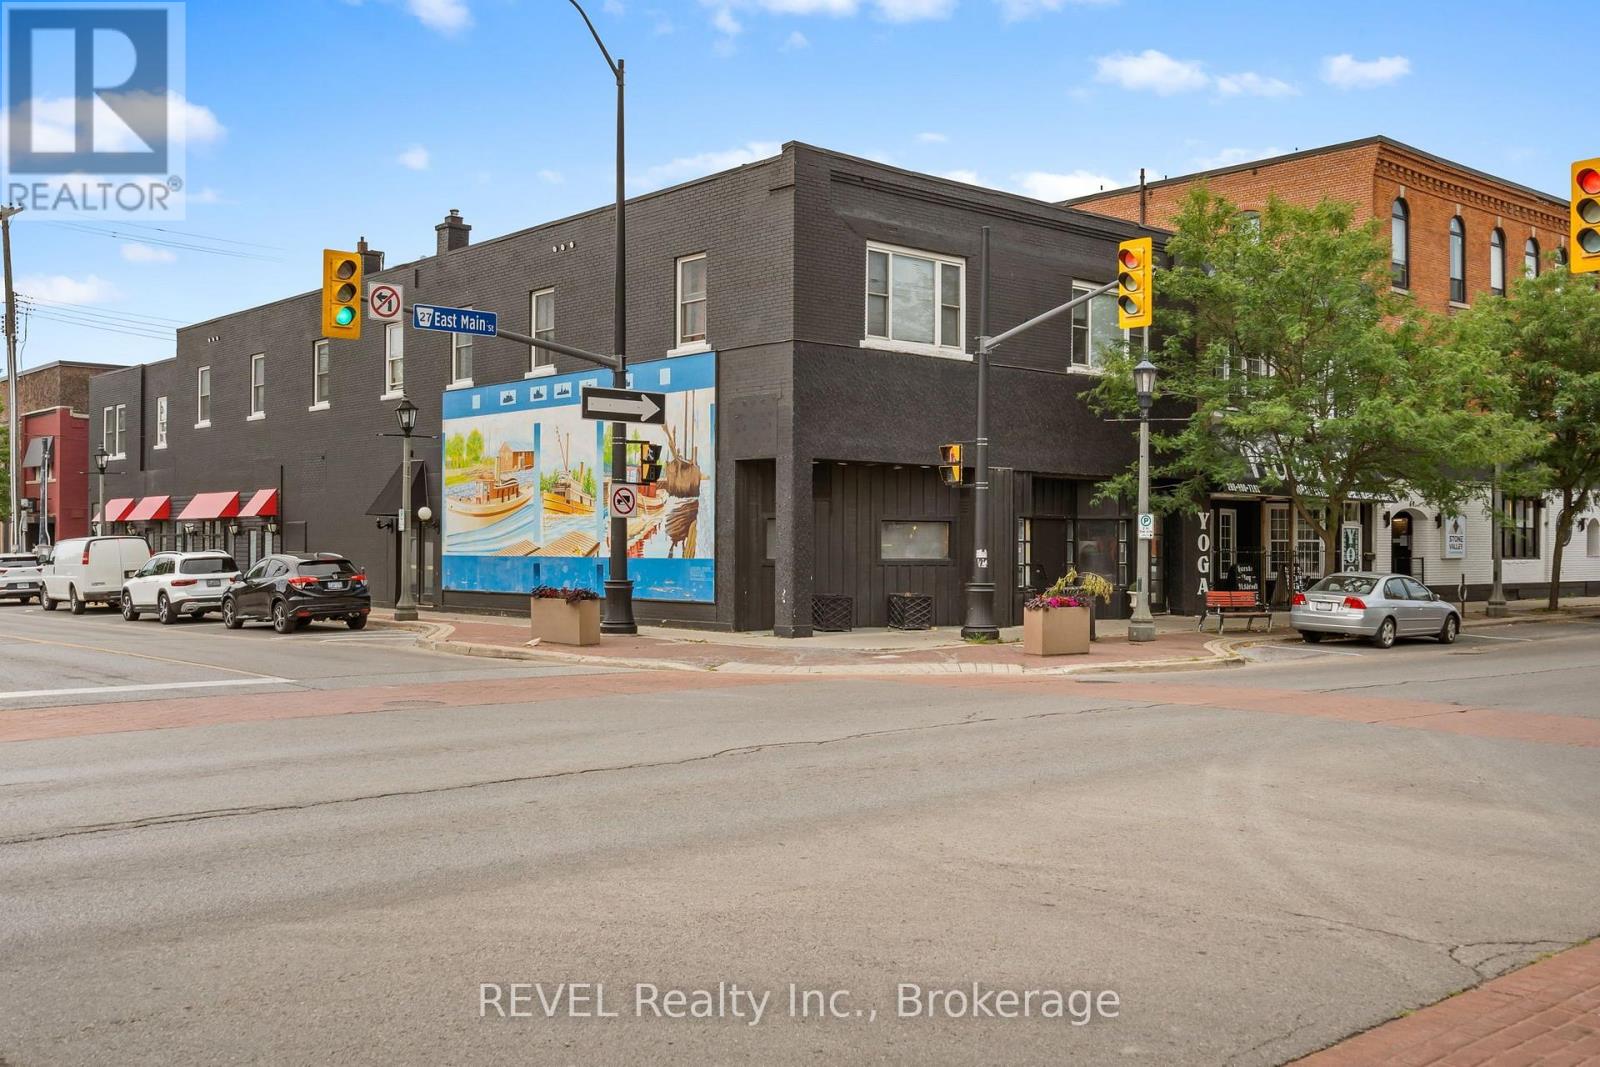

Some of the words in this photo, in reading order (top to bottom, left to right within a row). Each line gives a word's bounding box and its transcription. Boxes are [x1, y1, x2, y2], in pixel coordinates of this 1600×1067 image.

[419, 311, 432, 322] 27
[434, 311, 457, 328] East
[460, 314, 486, 331] Main
[1197, 511, 1210, 596] YOGA
